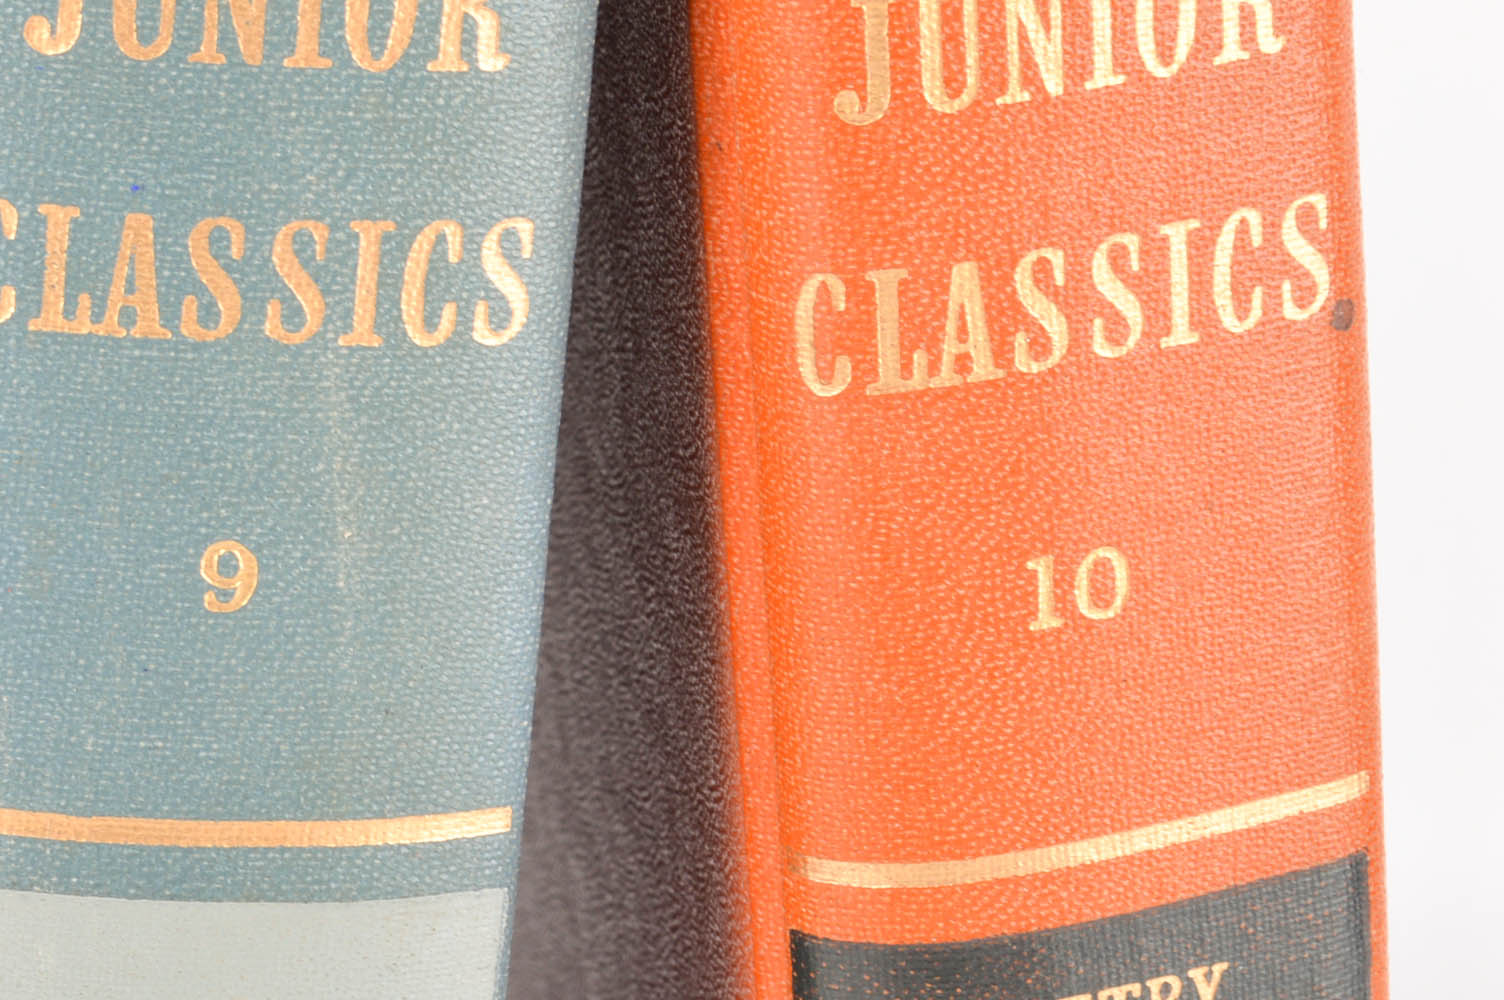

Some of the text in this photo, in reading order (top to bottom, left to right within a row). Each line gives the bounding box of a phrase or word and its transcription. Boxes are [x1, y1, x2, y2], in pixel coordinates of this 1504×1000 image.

[833, 0, 1286, 126] JUNIOR
[792, 192, 1332, 398] CLASSICS
[198, 539, 259, 615] 9
[1026, 545, 1131, 632] 10
